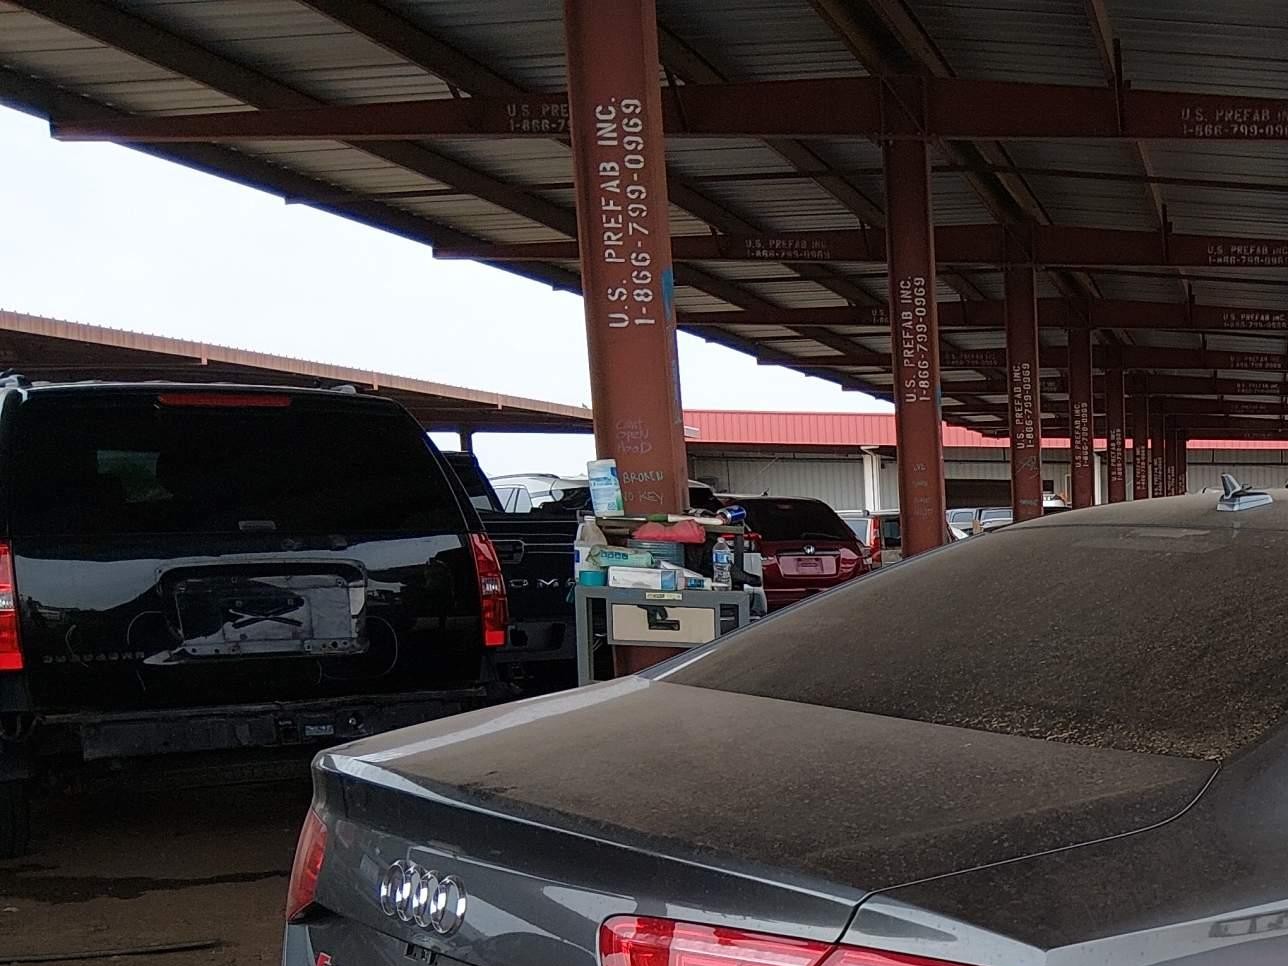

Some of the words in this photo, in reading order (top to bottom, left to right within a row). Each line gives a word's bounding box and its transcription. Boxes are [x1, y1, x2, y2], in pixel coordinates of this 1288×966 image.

[541, 104, 569, 117] PRE
[595, 97, 619, 146] INC.
[1215, 108, 1271, 121] PREFAB
[599, 161, 626, 263] PREFAB
[620, 98, 656, 325] 1-866-799-0969
[607, 279, 630, 328] U.S.
[899, 276, 912, 303] INC.
[901, 311, 916, 367] PREFAB
[913, 277, 931, 401] 1-866-799-0969
[905, 375, 917, 402] U.S.
